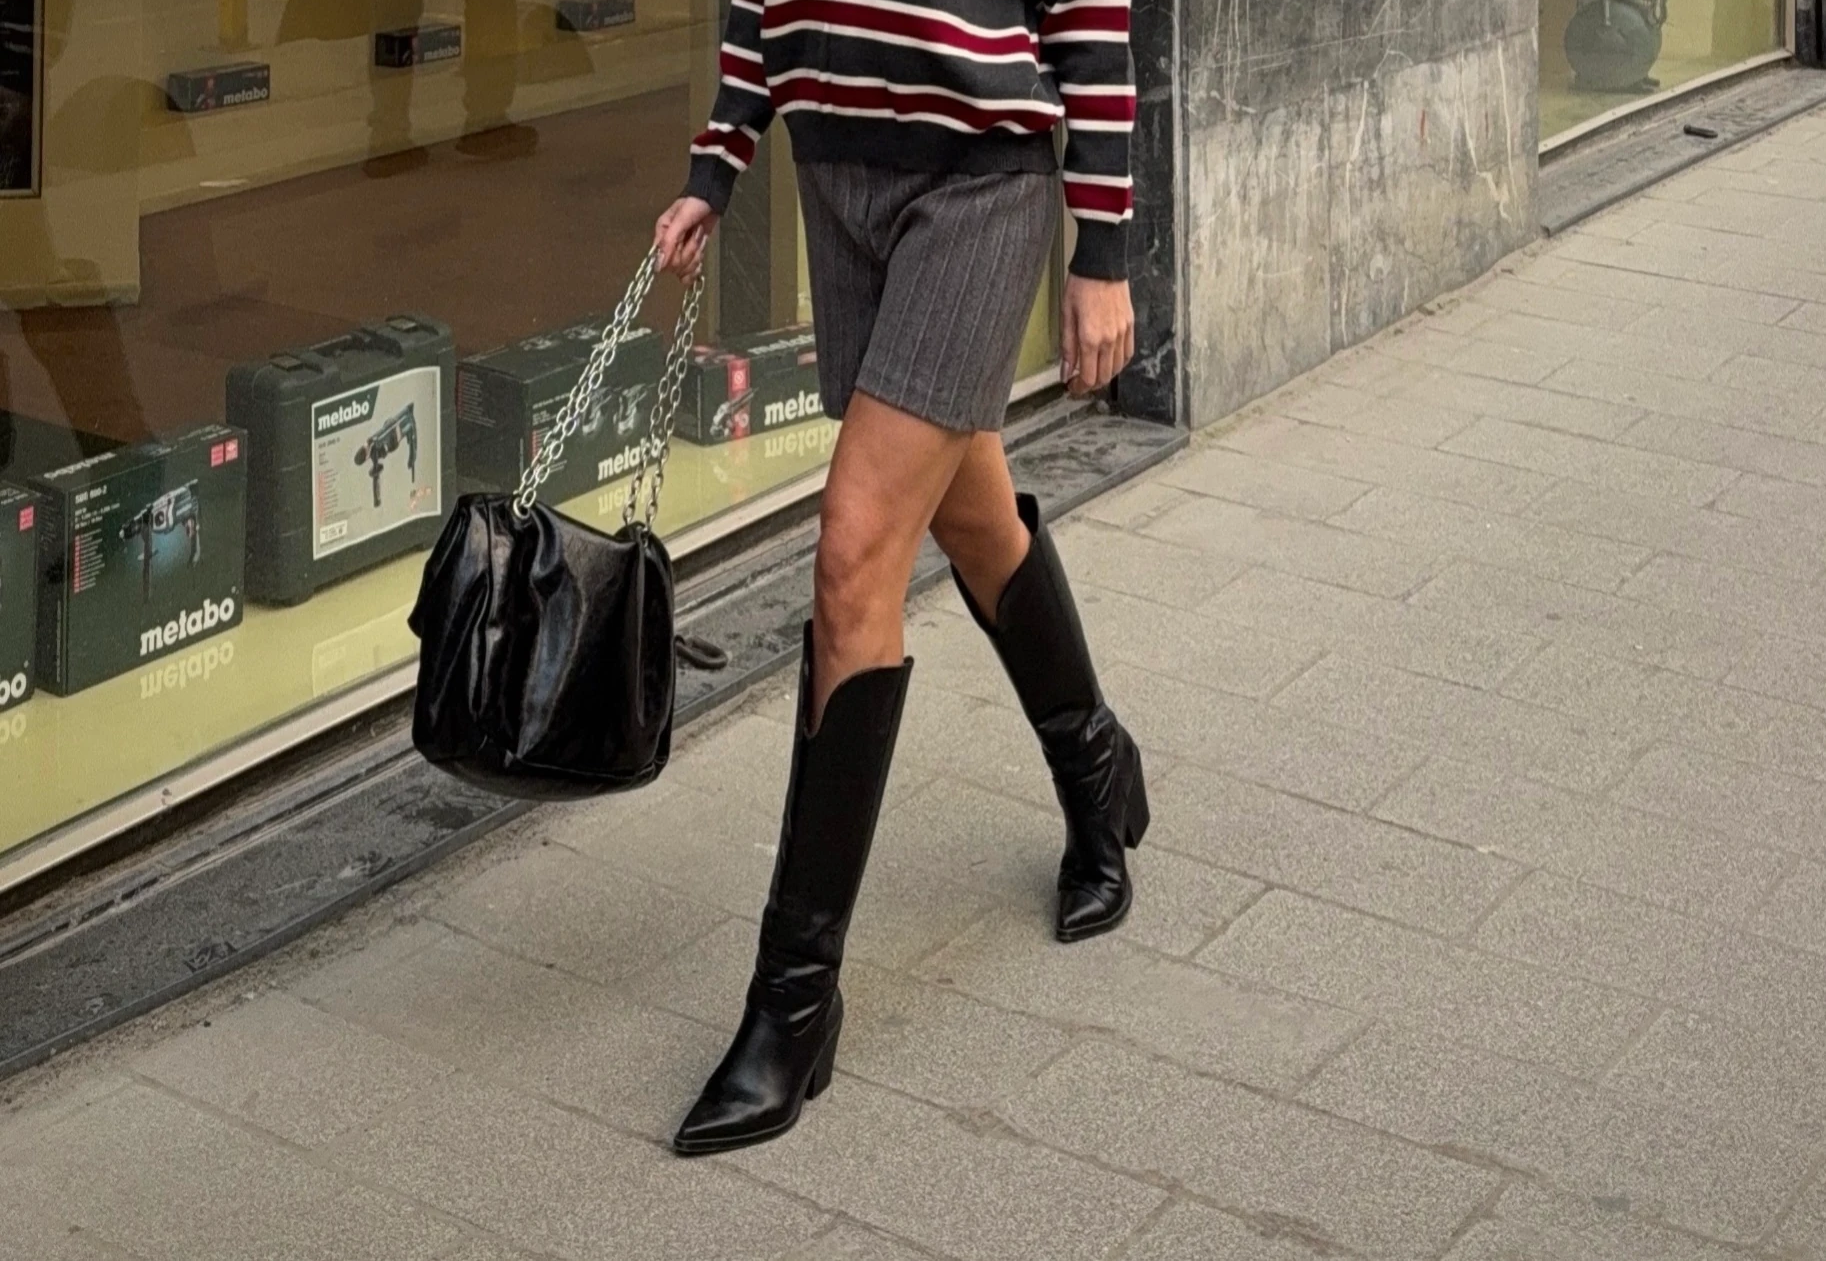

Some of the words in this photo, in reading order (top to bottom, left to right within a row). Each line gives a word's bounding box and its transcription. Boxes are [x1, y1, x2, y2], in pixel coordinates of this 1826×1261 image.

[224, 86, 268, 105] metabo
[318, 399, 369, 431] metabo
[764, 390, 824, 426] meta
[140, 598, 235, 657] metabo
